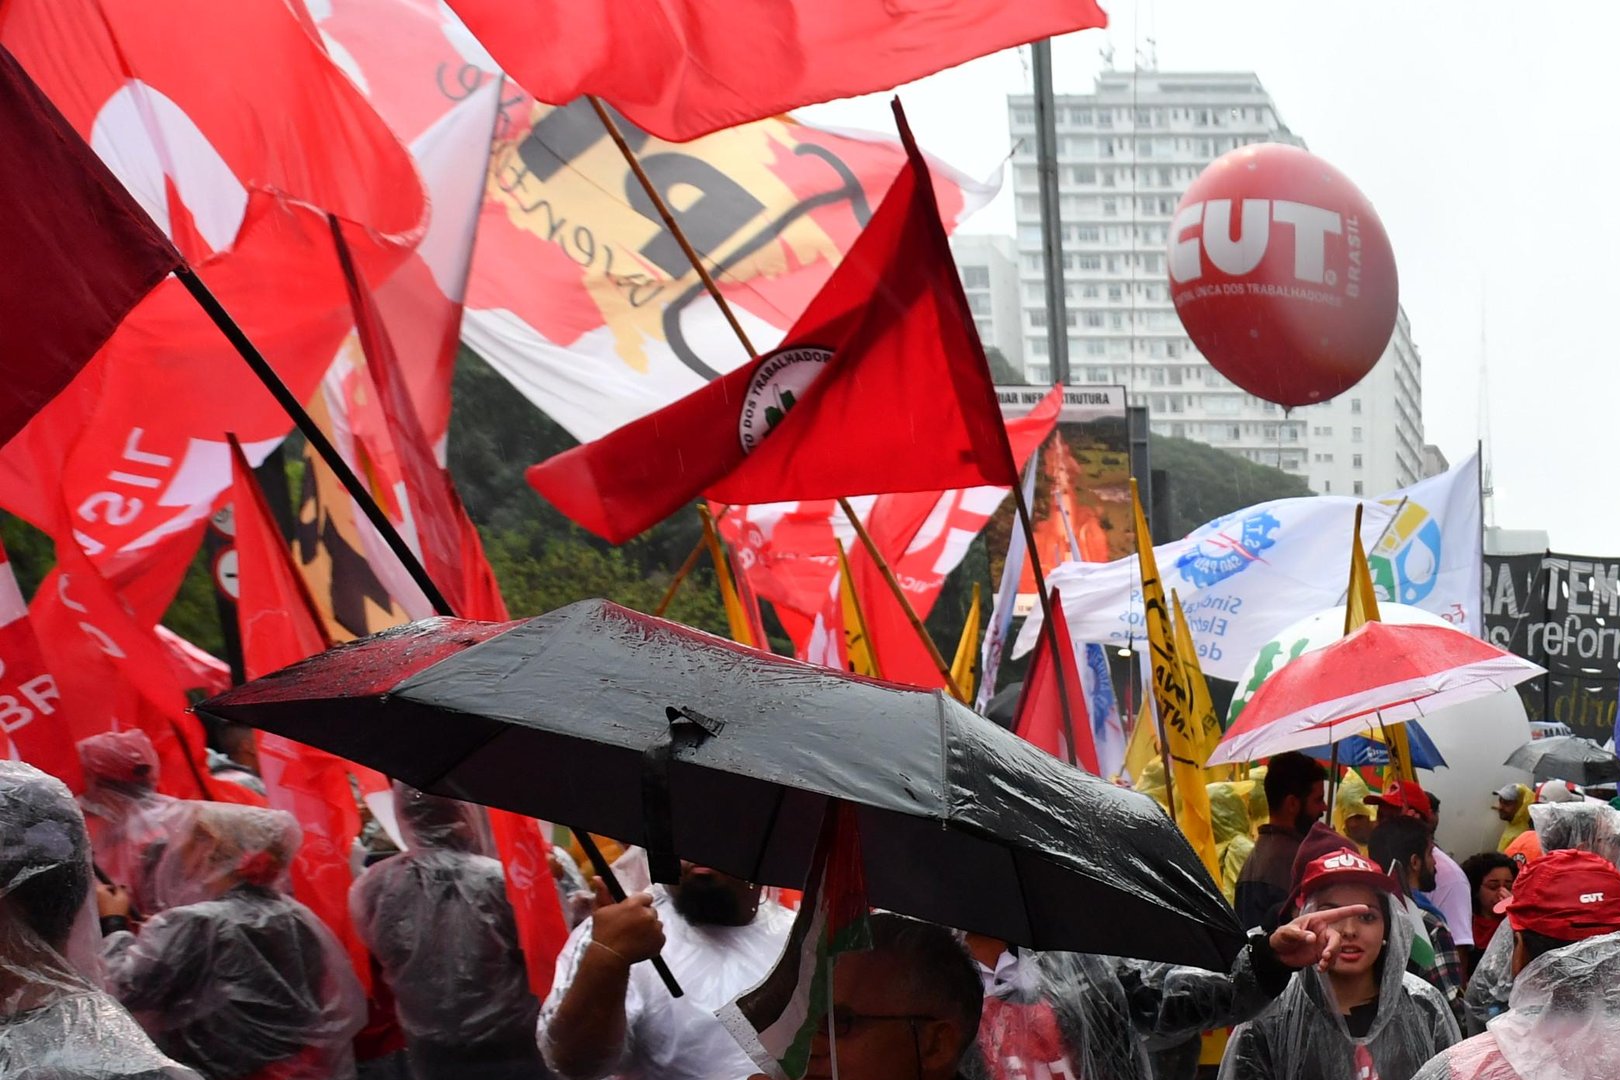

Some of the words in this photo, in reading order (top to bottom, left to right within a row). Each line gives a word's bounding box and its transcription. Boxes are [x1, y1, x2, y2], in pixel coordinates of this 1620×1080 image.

[1168, 198, 1342, 284] CUT
[1346, 214, 1362, 297] BRASIL
[1223, 283, 1245, 296] DOS
[743, 399, 757, 429] DOS
[1324, 853, 1370, 871] CUT
[1580, 893, 1604, 903] CUT
